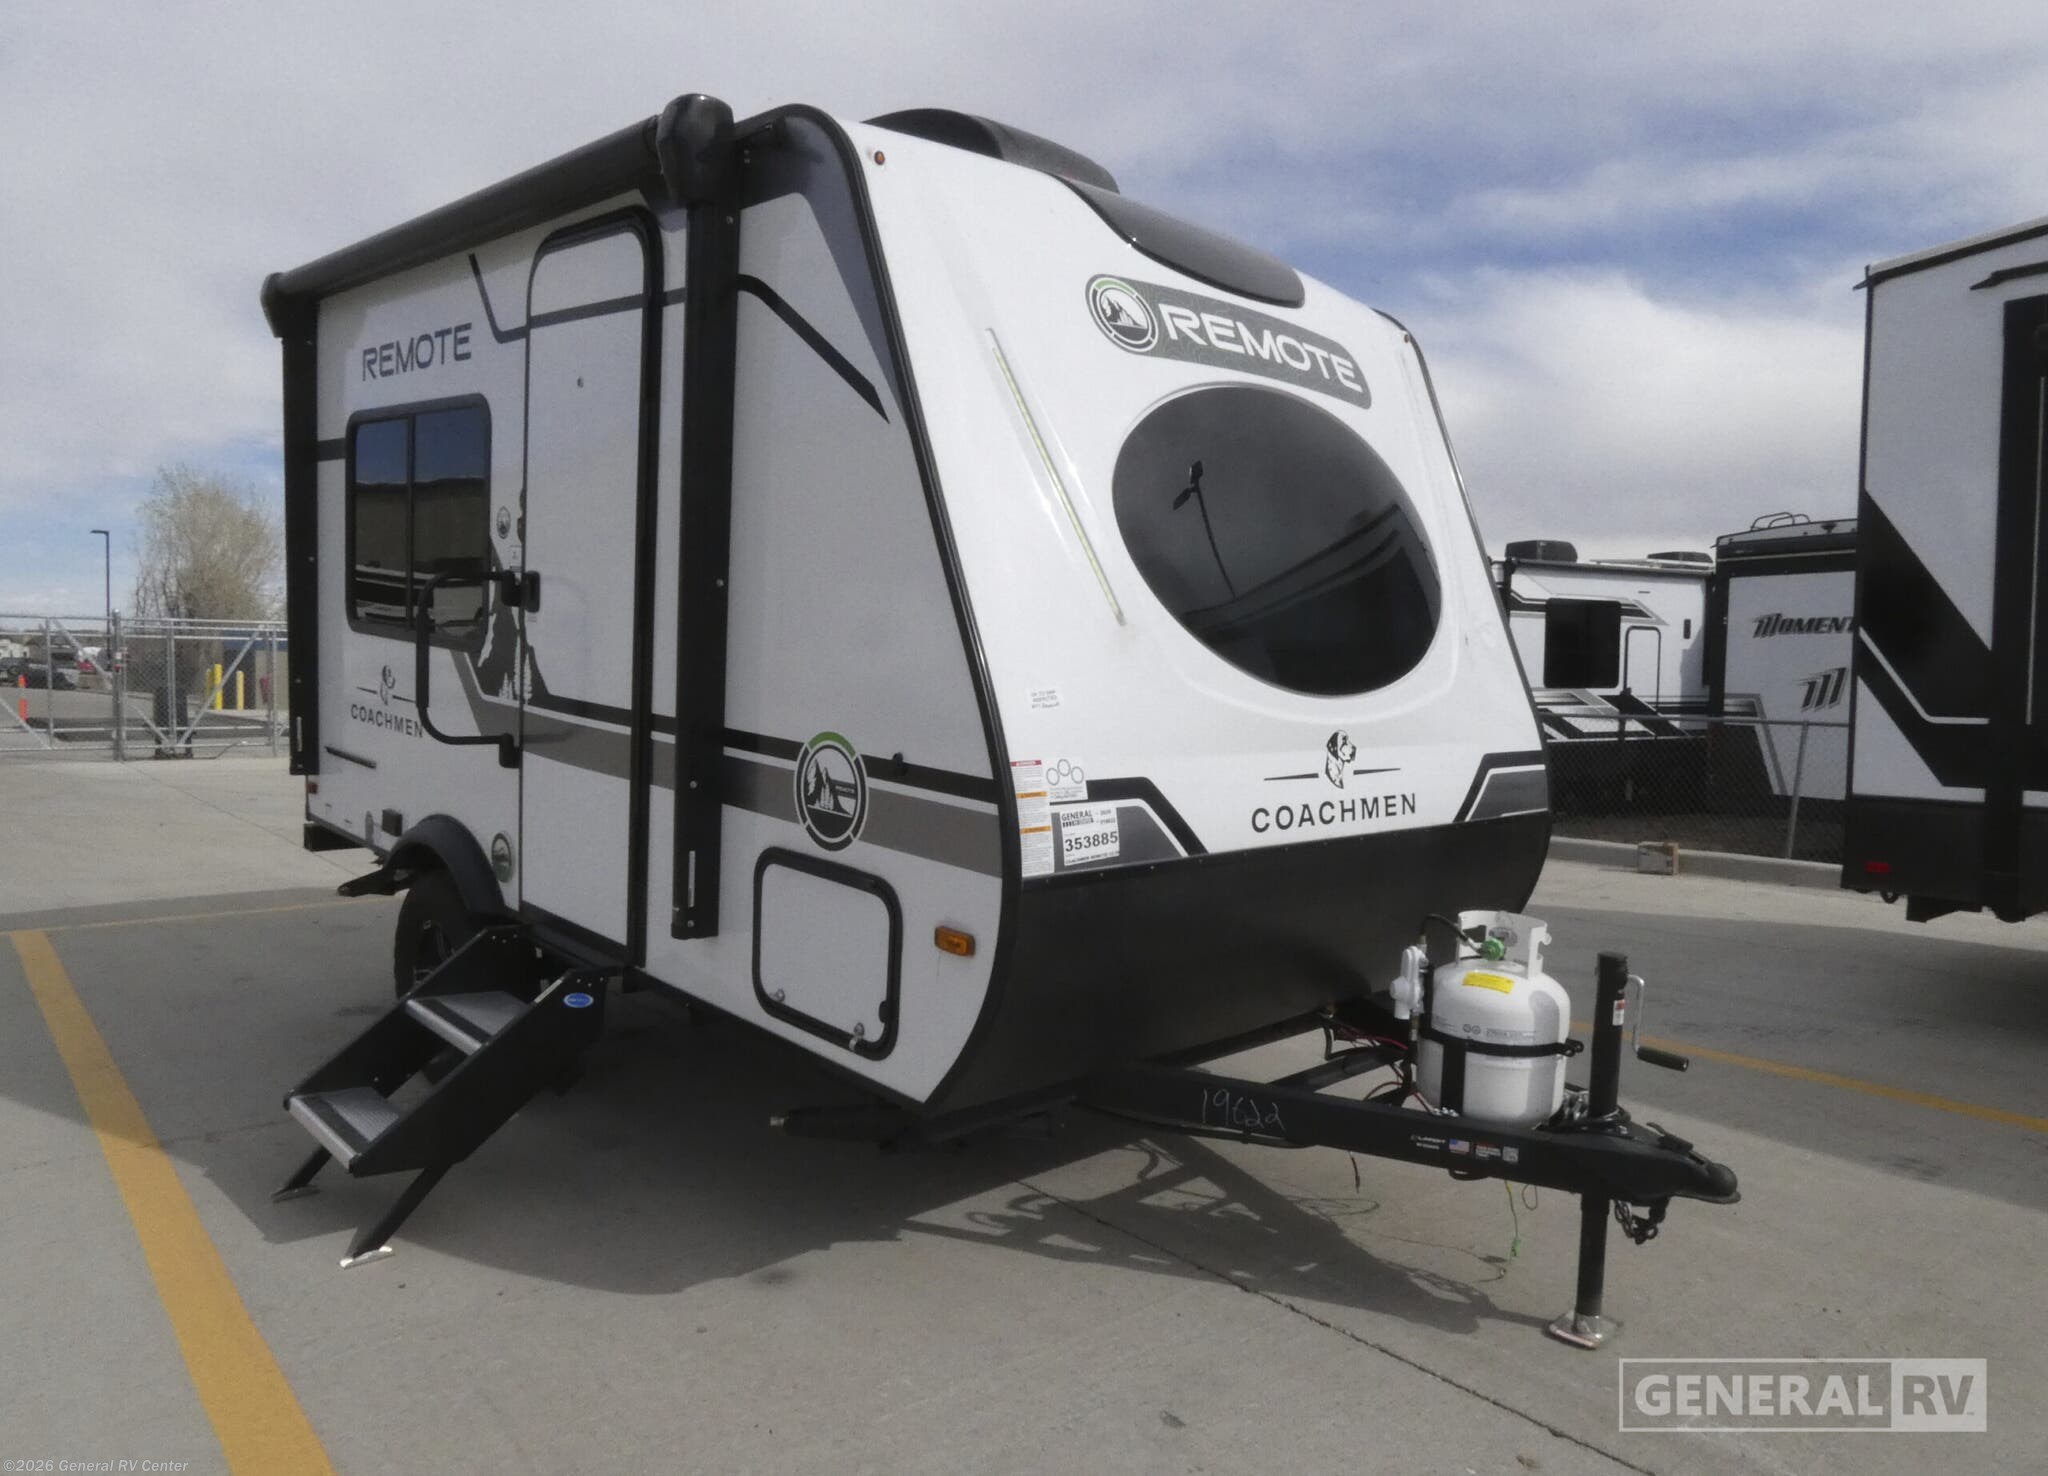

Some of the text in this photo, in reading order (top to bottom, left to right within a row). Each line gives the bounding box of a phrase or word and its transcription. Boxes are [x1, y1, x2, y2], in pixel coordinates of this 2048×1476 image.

[362, 322, 473, 381] REMOTE
[1164, 304, 1364, 393] REMOTE
[351, 703, 423, 738] COACHMEN
[1061, 809, 1093, 822] GENERAL
[1251, 793, 1416, 833] COACHMEN
[1064, 831, 1118, 852] 353885
